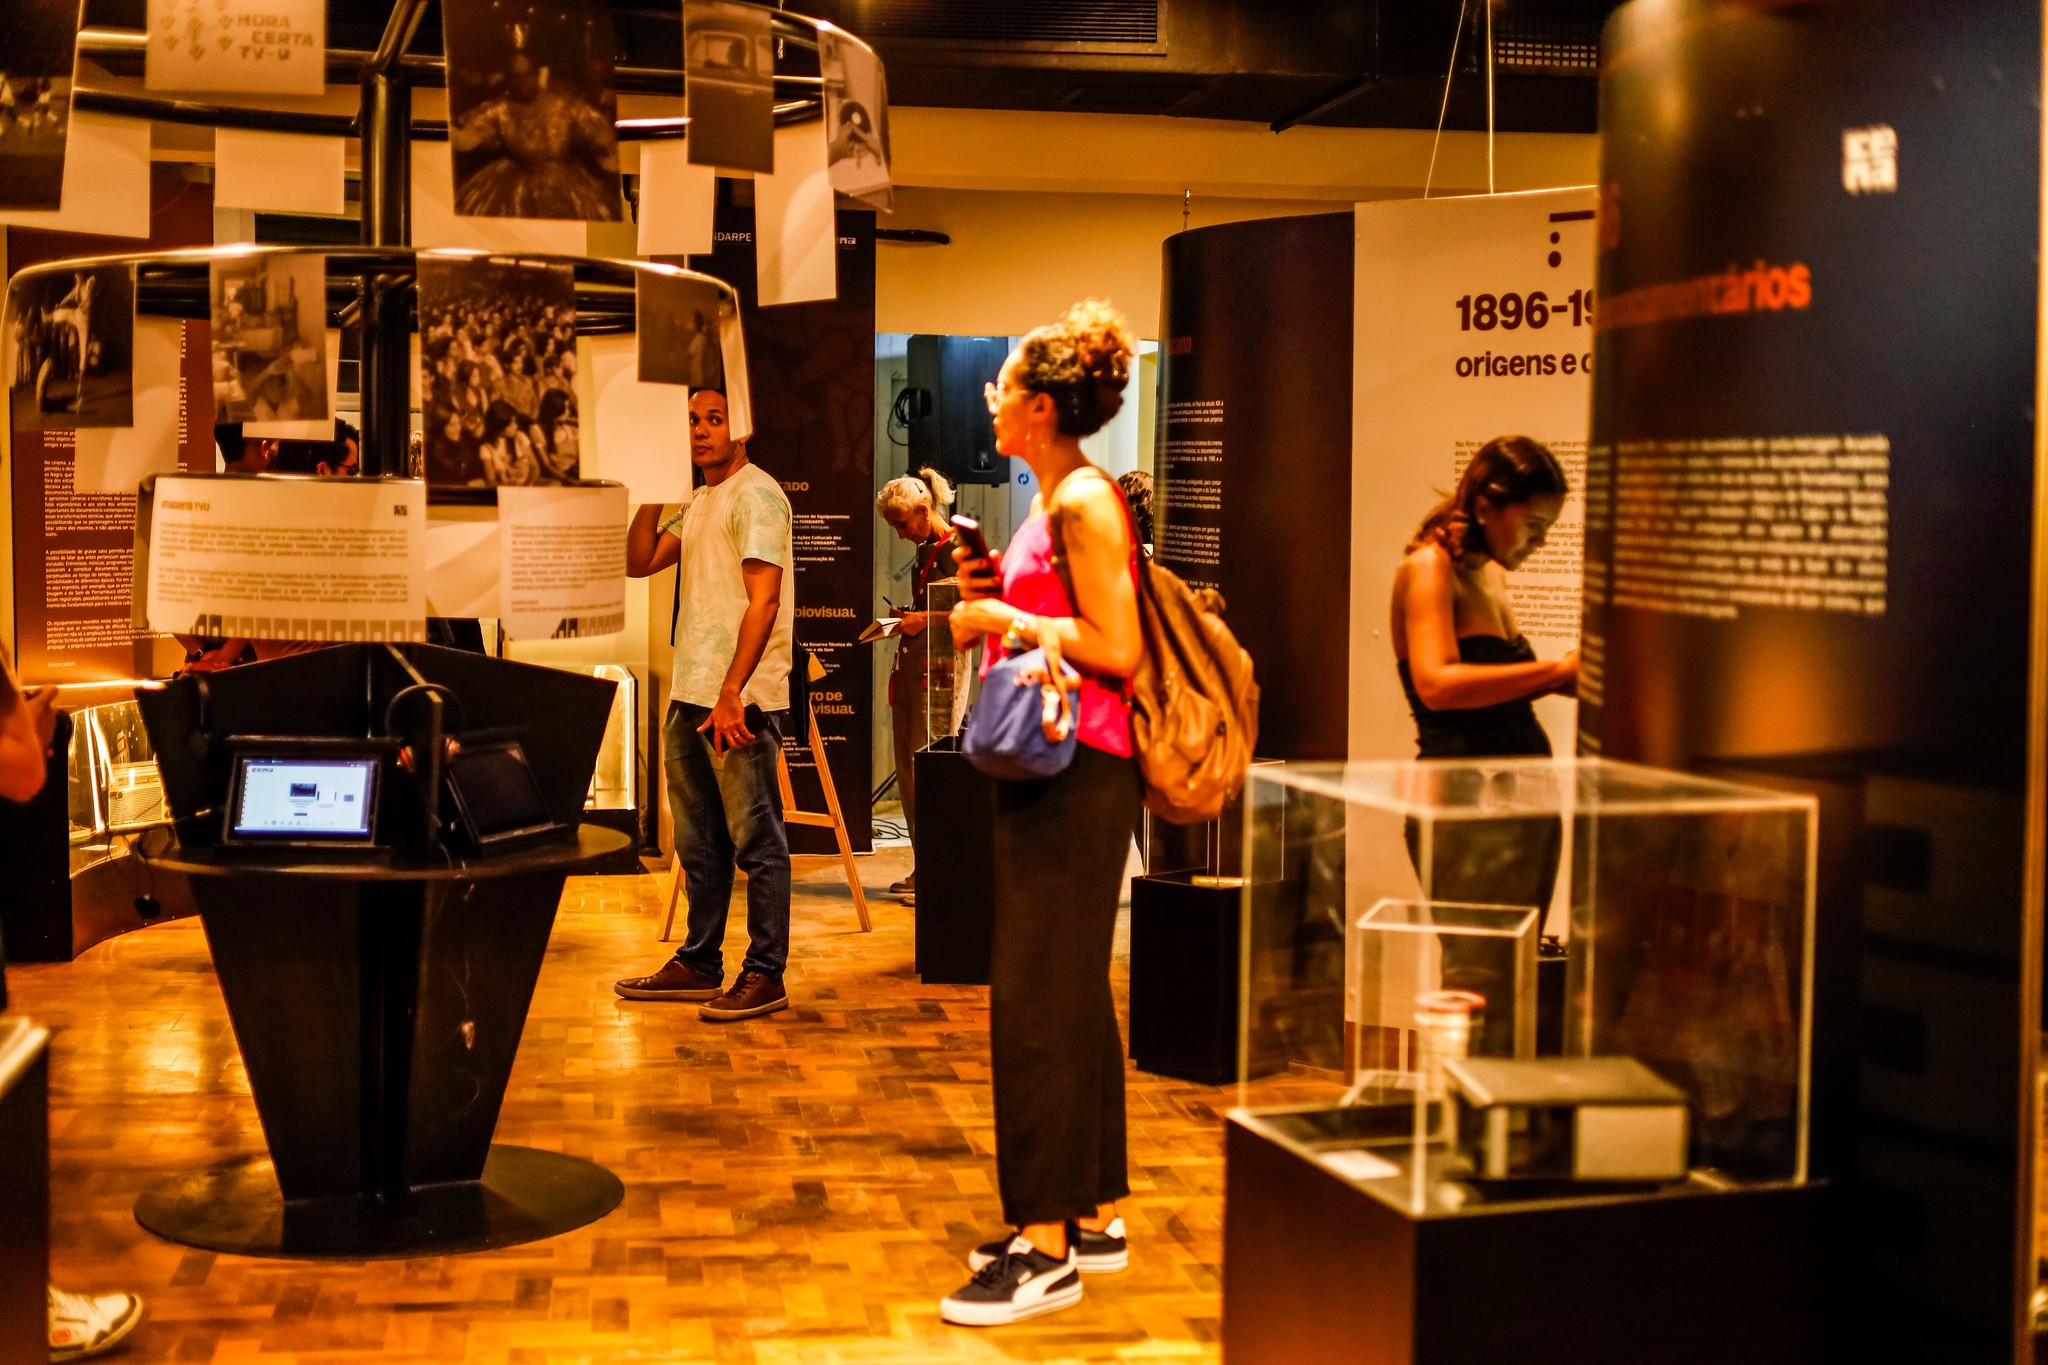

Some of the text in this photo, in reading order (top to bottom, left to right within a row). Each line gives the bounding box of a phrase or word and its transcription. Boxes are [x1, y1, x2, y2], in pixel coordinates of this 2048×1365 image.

[251, 30, 313, 47] CERTA
[1455, 351, 1577, 378] origens e
